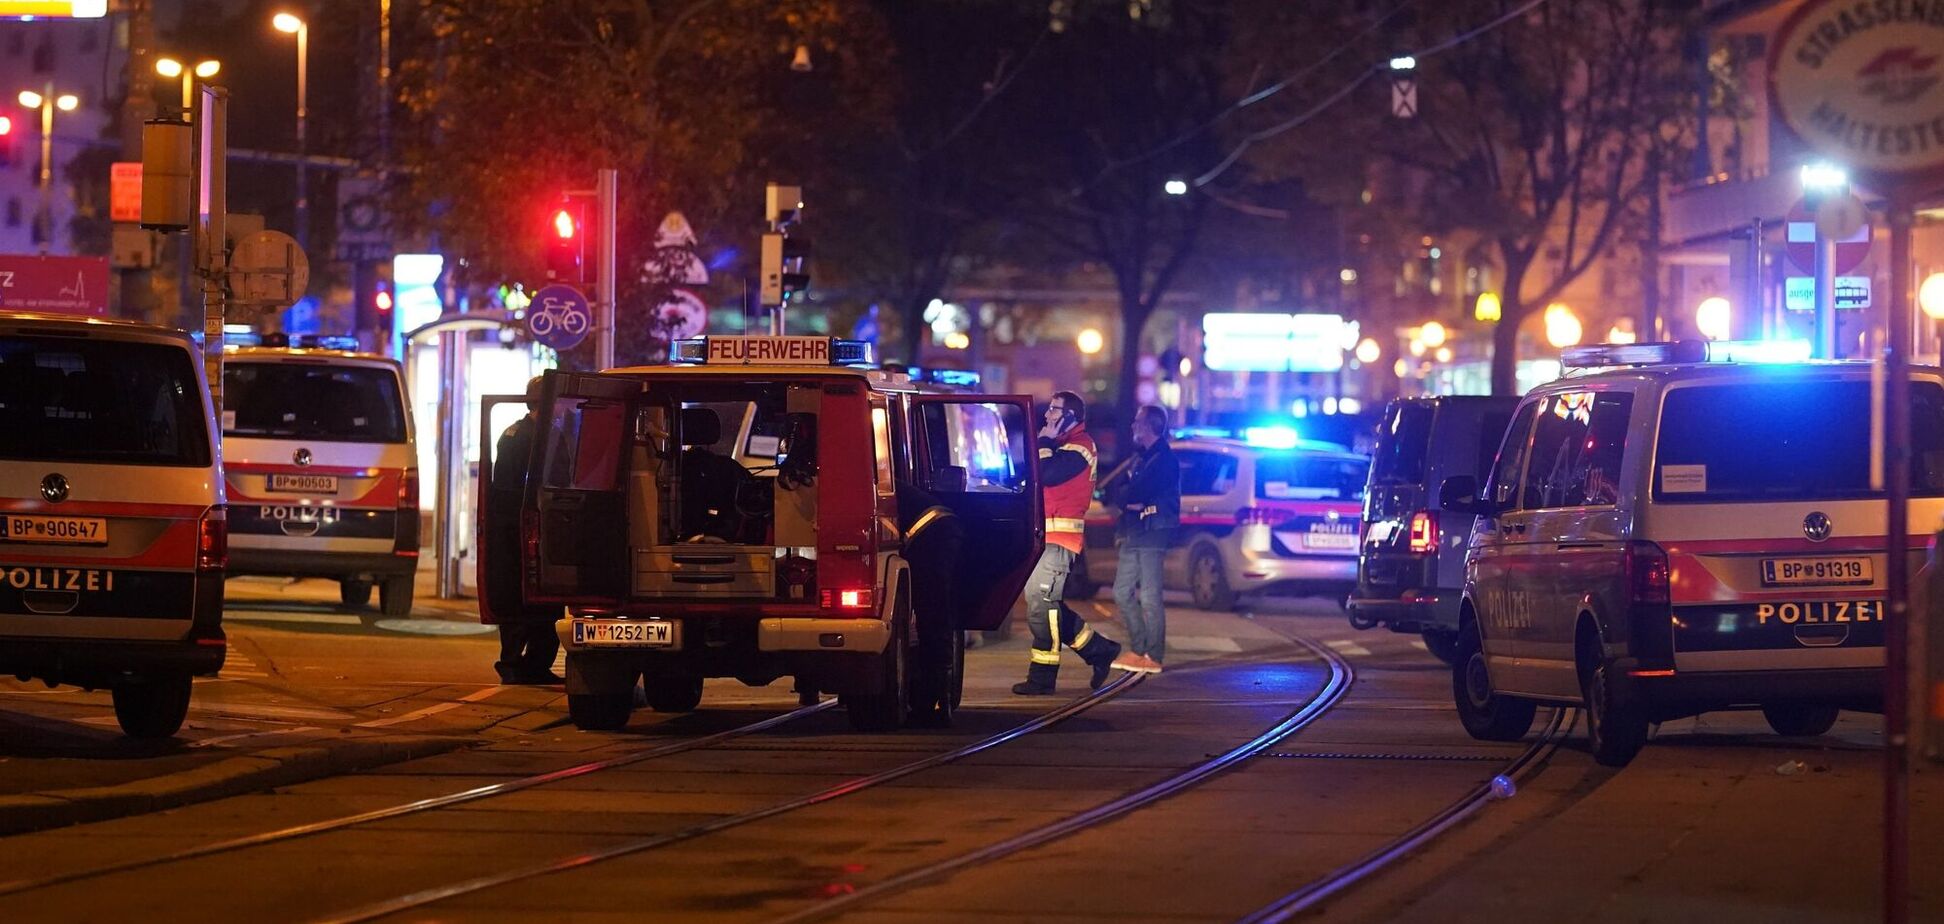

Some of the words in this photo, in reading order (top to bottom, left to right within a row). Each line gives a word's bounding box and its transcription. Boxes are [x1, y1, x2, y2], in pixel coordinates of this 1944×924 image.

[709, 339, 828, 360] FEUERWEHR
[260, 506, 341, 522] POLIZEI
[14, 519, 34, 535] BP
[47, 520, 99, 538] 90647
[1782, 563, 1802, 578] BP
[1816, 561, 1862, 577] 91319
[1488, 591, 1532, 628] POLIZEI
[1758, 600, 1885, 625] POLIZEI
[586, 626, 596, 640] W
[608, 626, 643, 640] 1252
[646, 626, 668, 640] FW
